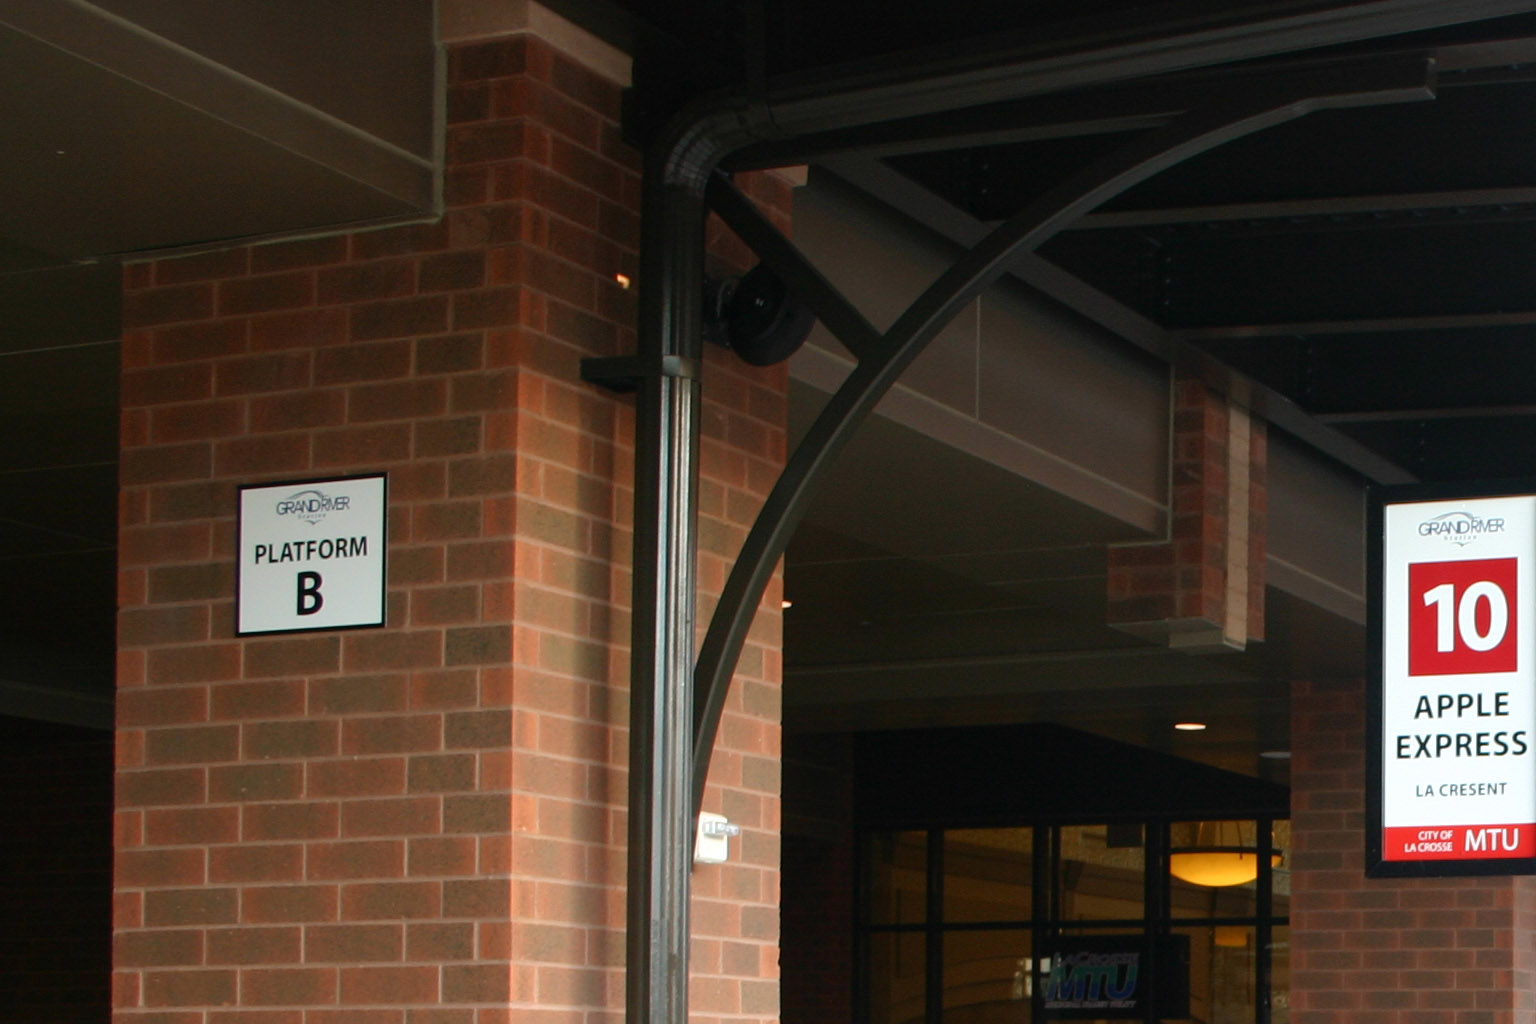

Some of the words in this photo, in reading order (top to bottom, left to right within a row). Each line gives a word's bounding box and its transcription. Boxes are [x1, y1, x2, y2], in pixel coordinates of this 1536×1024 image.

[255, 536, 367, 564] PLATFORM
[296, 571, 324, 616] B
[1423, 580, 1509, 653] 10
[1414, 692, 1510, 720] APPLE
[1396, 730, 1528, 760] EXPRESS
[1416, 784, 1434, 798] LA
[1439, 782, 1508, 797] CRESENT
[1404, 843, 1416, 853] LA
[1418, 842, 1453, 852] CROSSE
[1418, 831, 1439, 841] CITY
[1440, 830, 1454, 840] OF
[1464, 828, 1519, 851] MTU
[1046, 963, 1138, 1000] MTU
